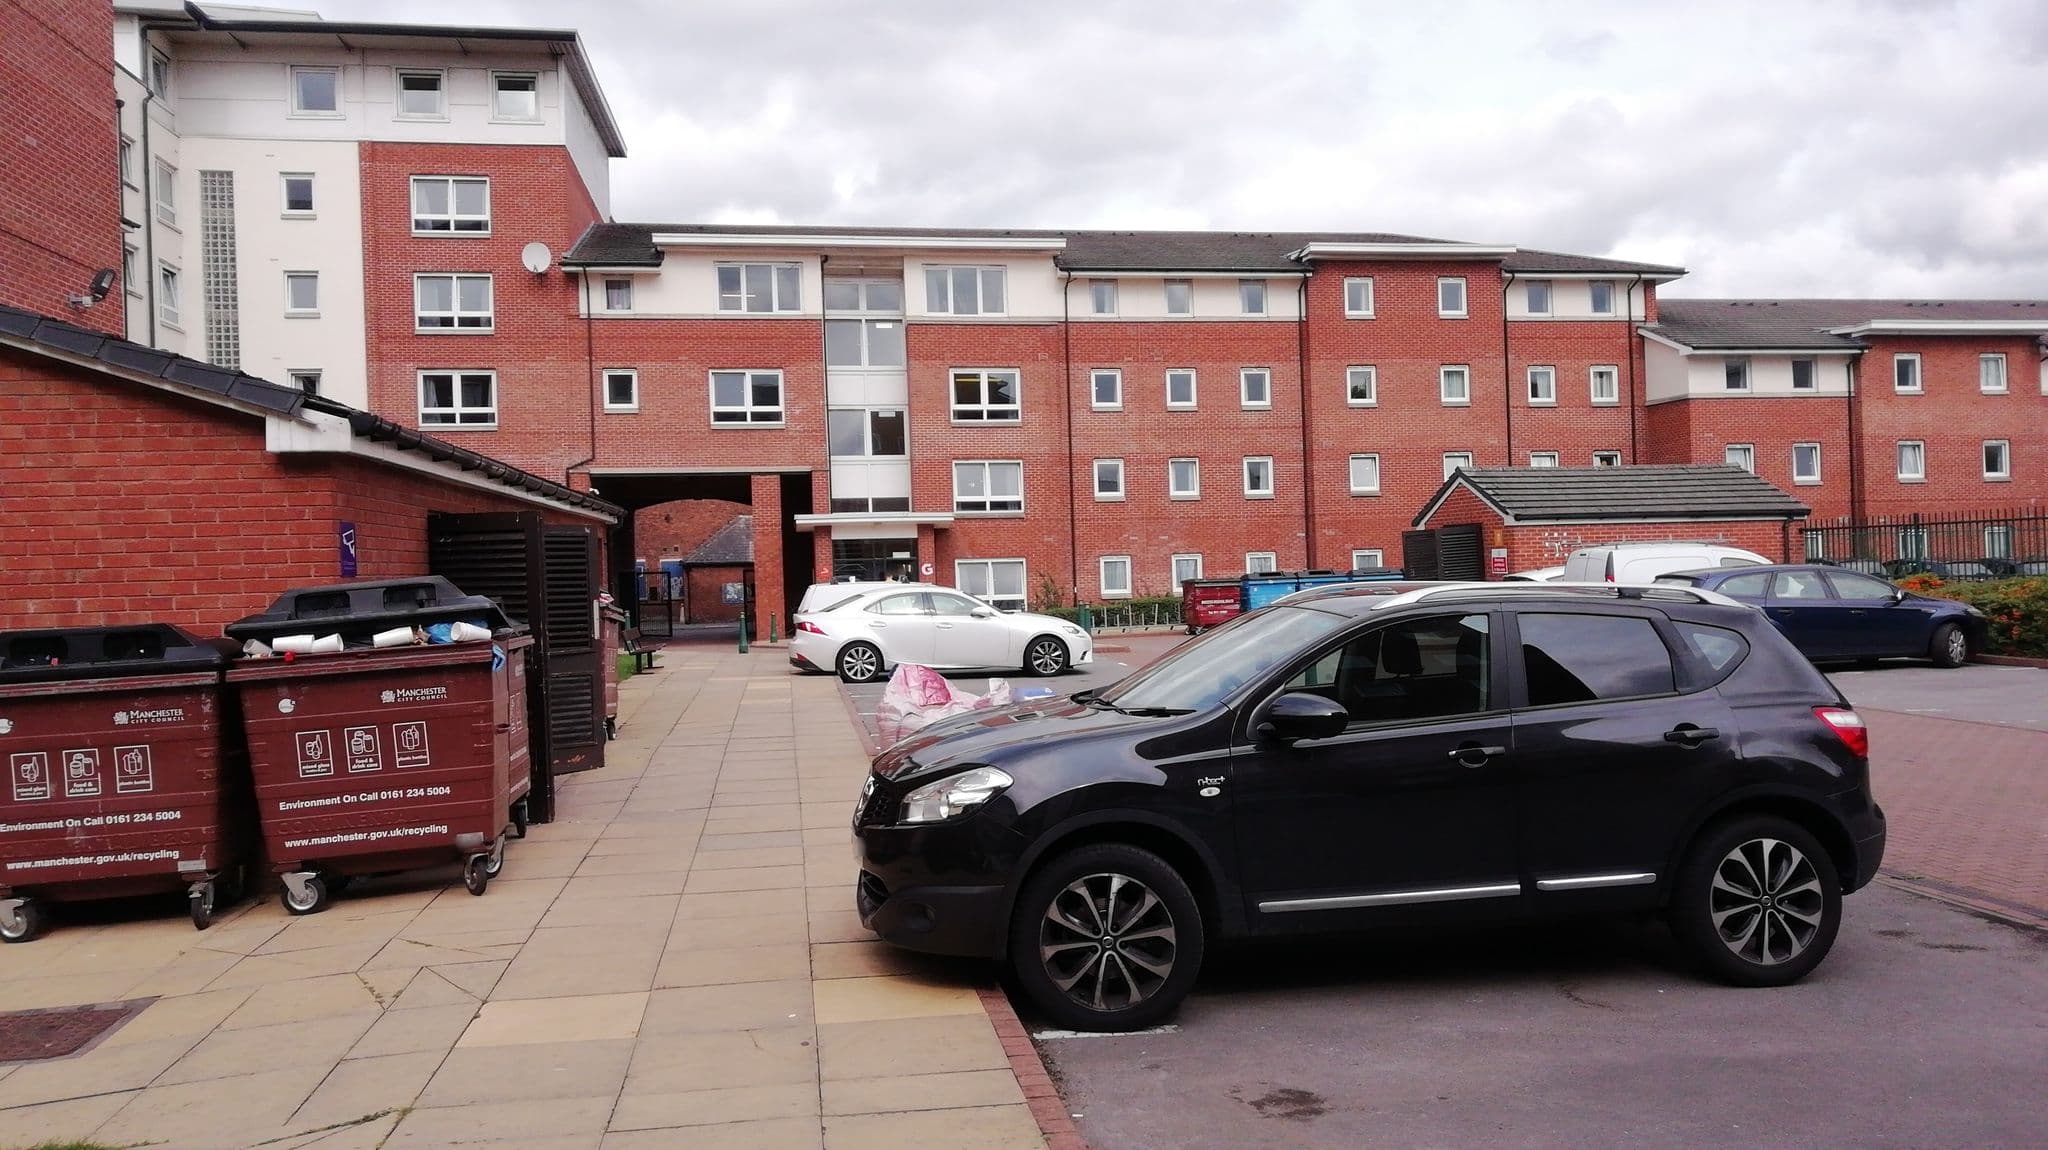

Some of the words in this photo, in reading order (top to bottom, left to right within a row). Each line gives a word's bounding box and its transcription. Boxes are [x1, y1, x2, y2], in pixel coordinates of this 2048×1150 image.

[921, 563, 934, 576] G
[279, 796, 341, 810] Environment
[343, 793, 357, 803] On
[359, 791, 379, 802] Call
[380, 789, 404, 800] 0161
[406, 787, 425, 798] 234
[426, 786, 451, 796] 5004
[0, 820, 64, 832] Environment
[65, 818, 82, 827] On
[83, 816, 104, 826] Call
[106, 814, 131, 825] 0161
[133, 812, 153, 822] 234
[155, 810, 182, 821] 5004
[284, 824, 449, 848] www.manchester.gov.uk/recycling
[6, 850, 180, 871] www.manchester.gov.uk/recycling
